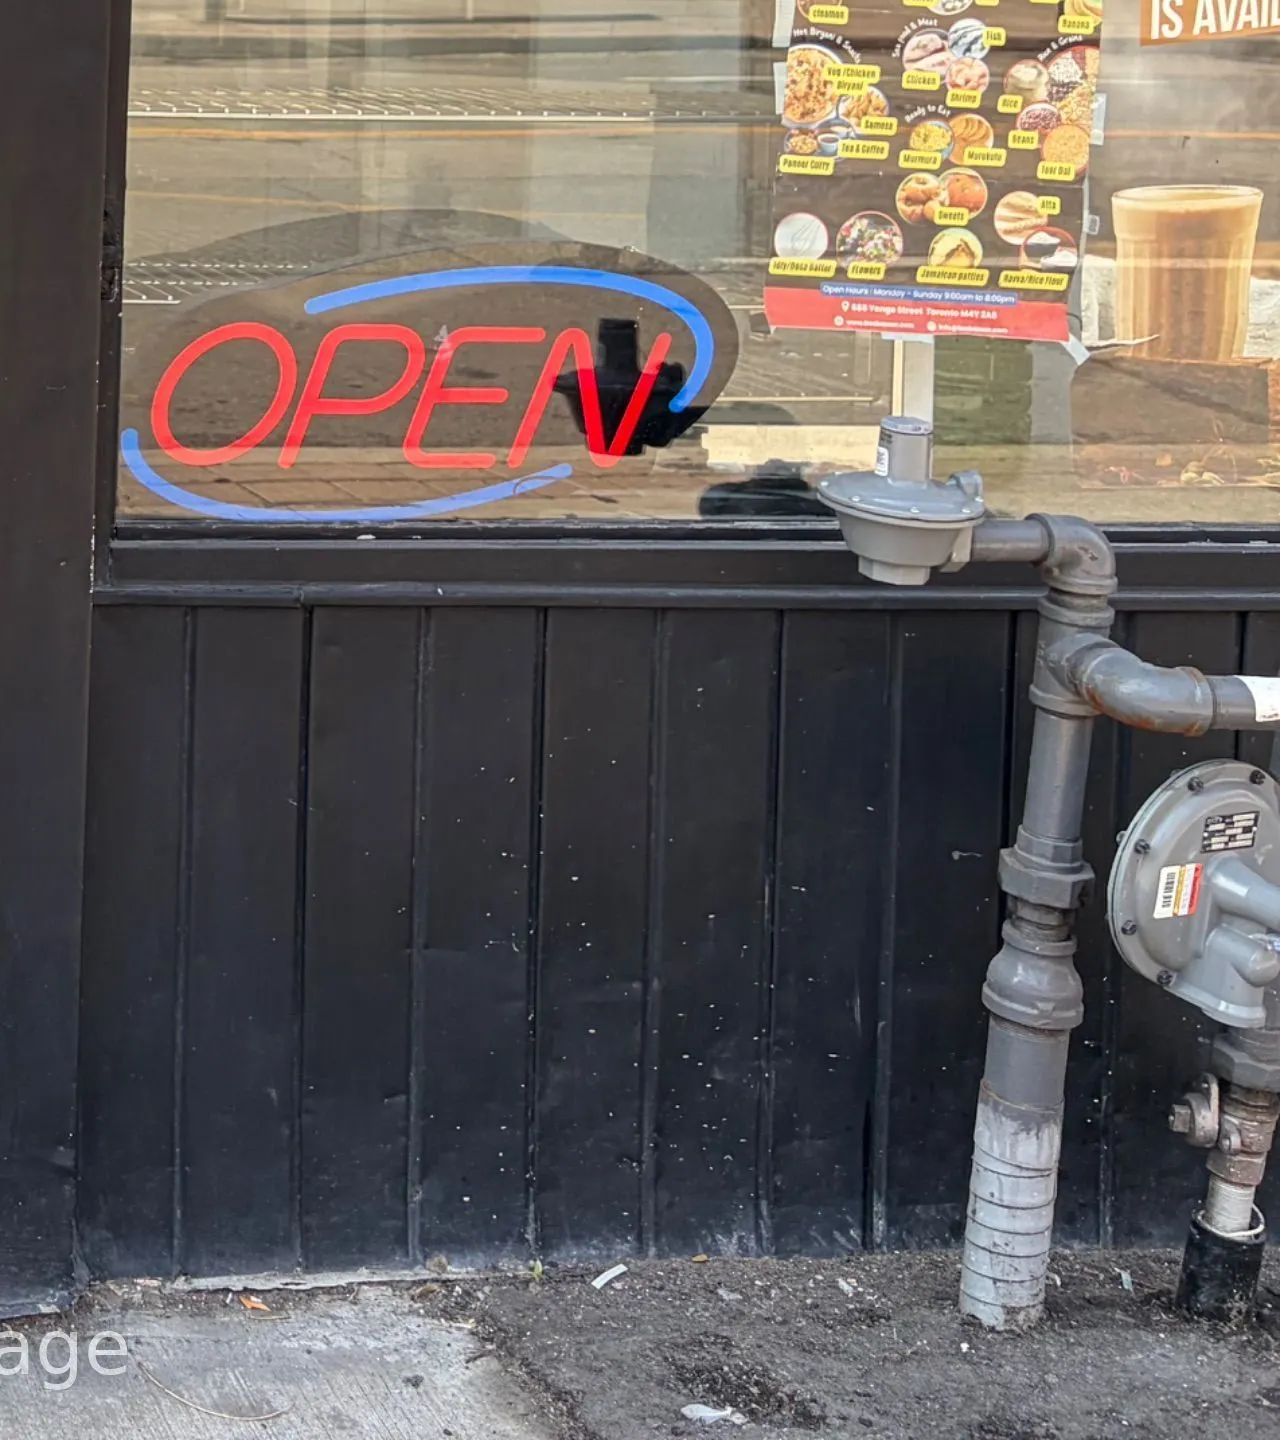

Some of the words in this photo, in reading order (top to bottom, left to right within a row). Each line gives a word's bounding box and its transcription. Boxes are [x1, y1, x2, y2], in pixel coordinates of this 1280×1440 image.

[1062, 19, 1090, 30] Banana
[986, 30, 1002, 41] Fish
[906, 75, 937, 86] Chicken
[950, 93, 977, 104] Shrimp
[1002, 99, 1019, 109] Rice
[864, 120, 893, 132] Samosa
[1012, 134, 1034, 145] Beans
[862, 144, 885, 155] Coffee
[1041, 200, 1057, 210] Atta
[822, 284, 843, 295] Open
[845, 286, 868, 296] Hours
[873, 288, 905, 299] Monday
[913, 290, 941, 301] Sunday
[869, 304, 896, 316] Yonge
[897, 305, 923, 315] Street
[926, 307, 959, 317] Toronto
[151, 321, 673, 468] OPEN
